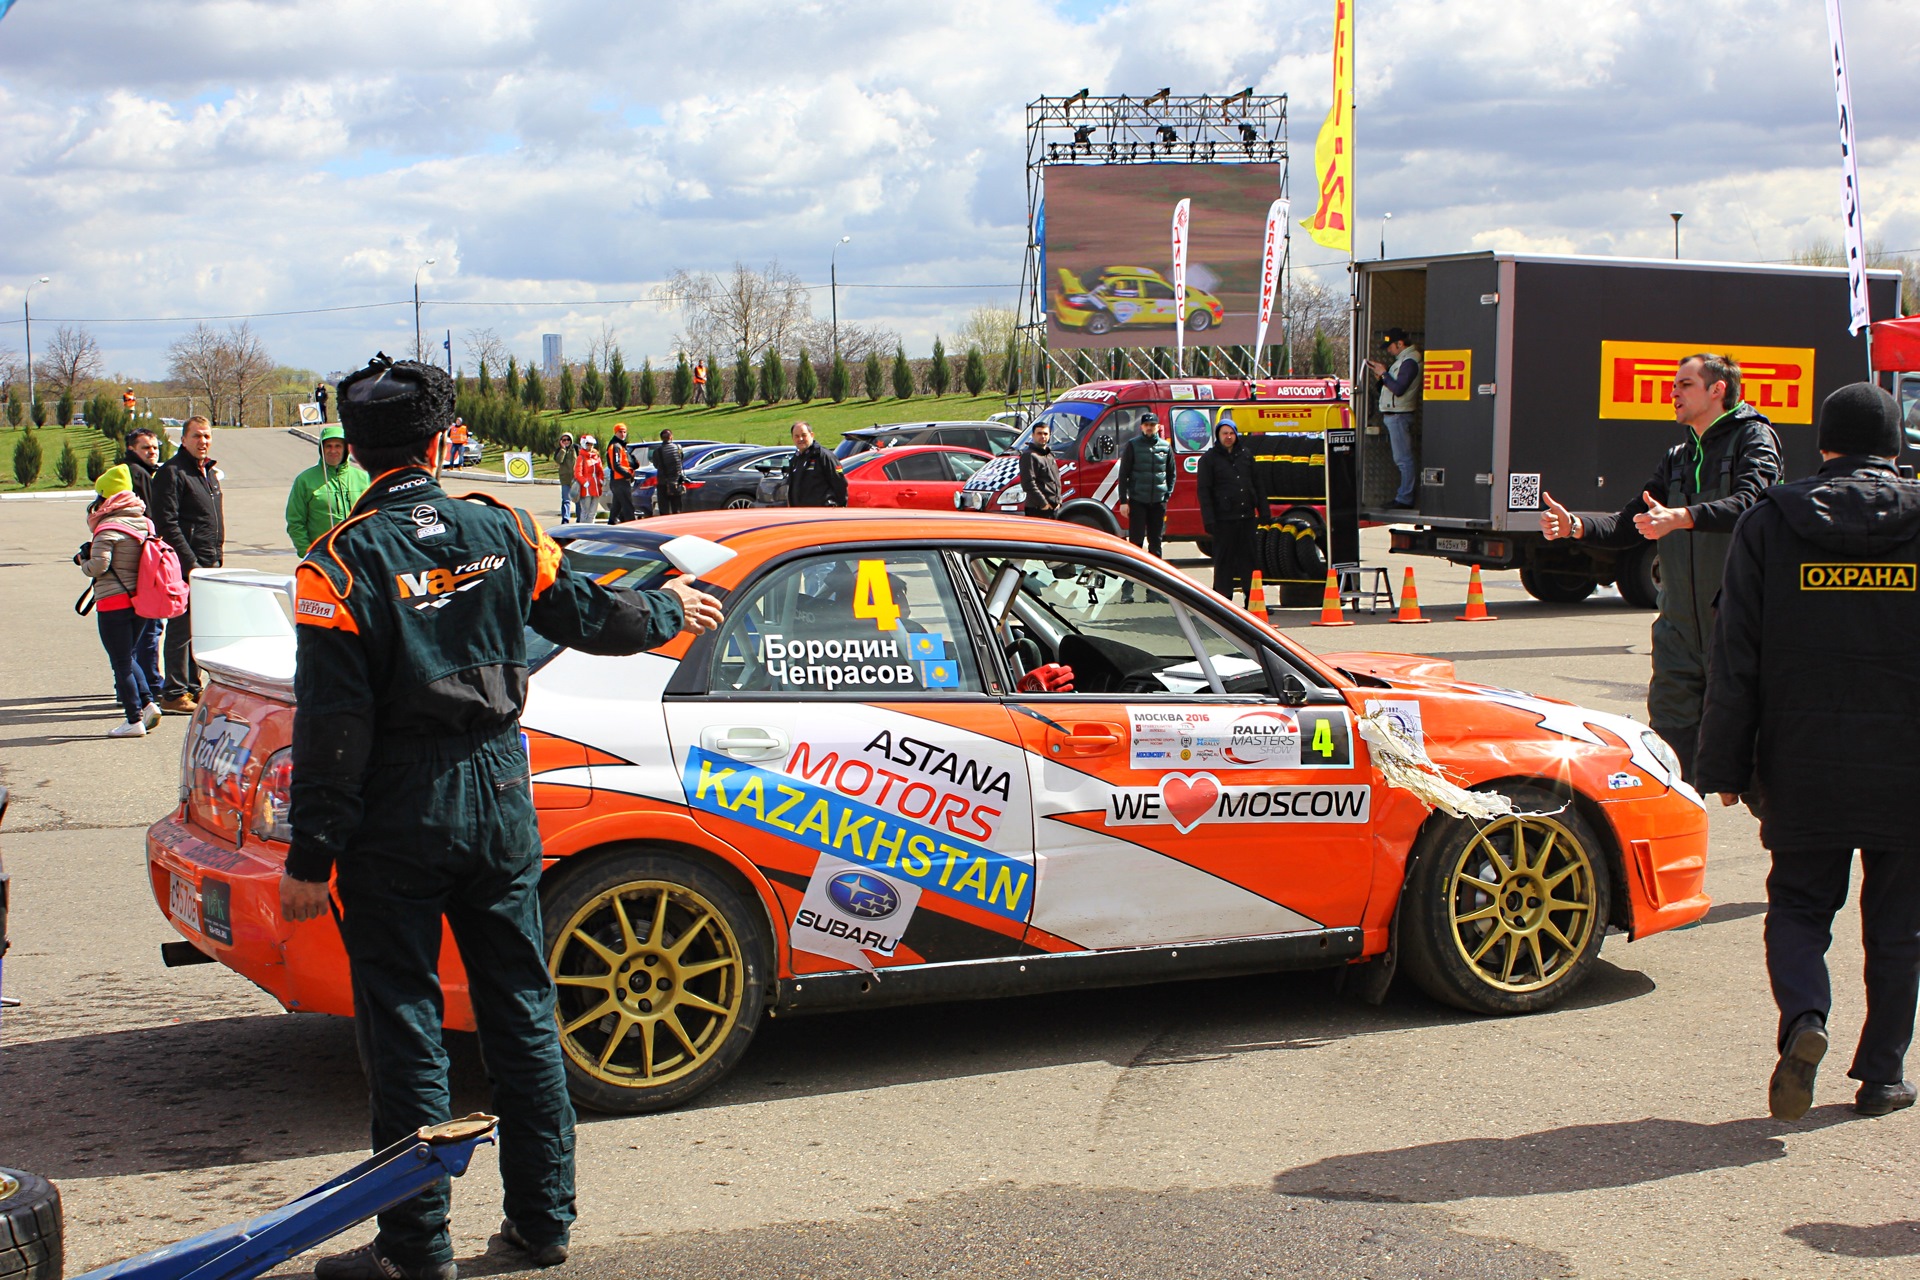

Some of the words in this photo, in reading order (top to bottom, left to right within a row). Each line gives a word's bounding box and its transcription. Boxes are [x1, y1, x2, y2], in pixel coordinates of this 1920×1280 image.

[1261, 219, 1275, 323] КЛАССИКА
[1277, 386, 1326, 396] АВТОСПОРТ
[1612, 357, 1802, 408] PILLI
[1258, 408, 1313, 419] PIRELLI
[1328, 431, 1355, 444] PIRELLI
[455, 554, 507, 575] rally
[1806, 567, 1910, 586] ОХРАНА
[853, 559, 901, 631] 4
[298, 603, 331, 616] ПЕРИЯ
[764, 634, 899, 665] Бородин
[766, 660, 915, 691] Чепрасов
[1134, 713, 1184, 722] МОСКВА
[1185, 713, 1210, 722] 2016
[1233, 726, 1279, 735] RALLY
[1230, 735, 1295, 746] MASTERS
[1259, 746, 1293, 755] SHOW
[1312, 718, 1335, 757] 4
[863, 729, 1011, 802] ASTANA
[785, 741, 1002, 843] MOTORS
[1111, 792, 1161, 820] WE
[1217, 790, 1366, 818] MOSCOW
[695, 759, 1029, 912] KAZAKHSTAN
[796, 909, 900, 952] SUBARU
[381, 1257, 402, 1280] OMP
